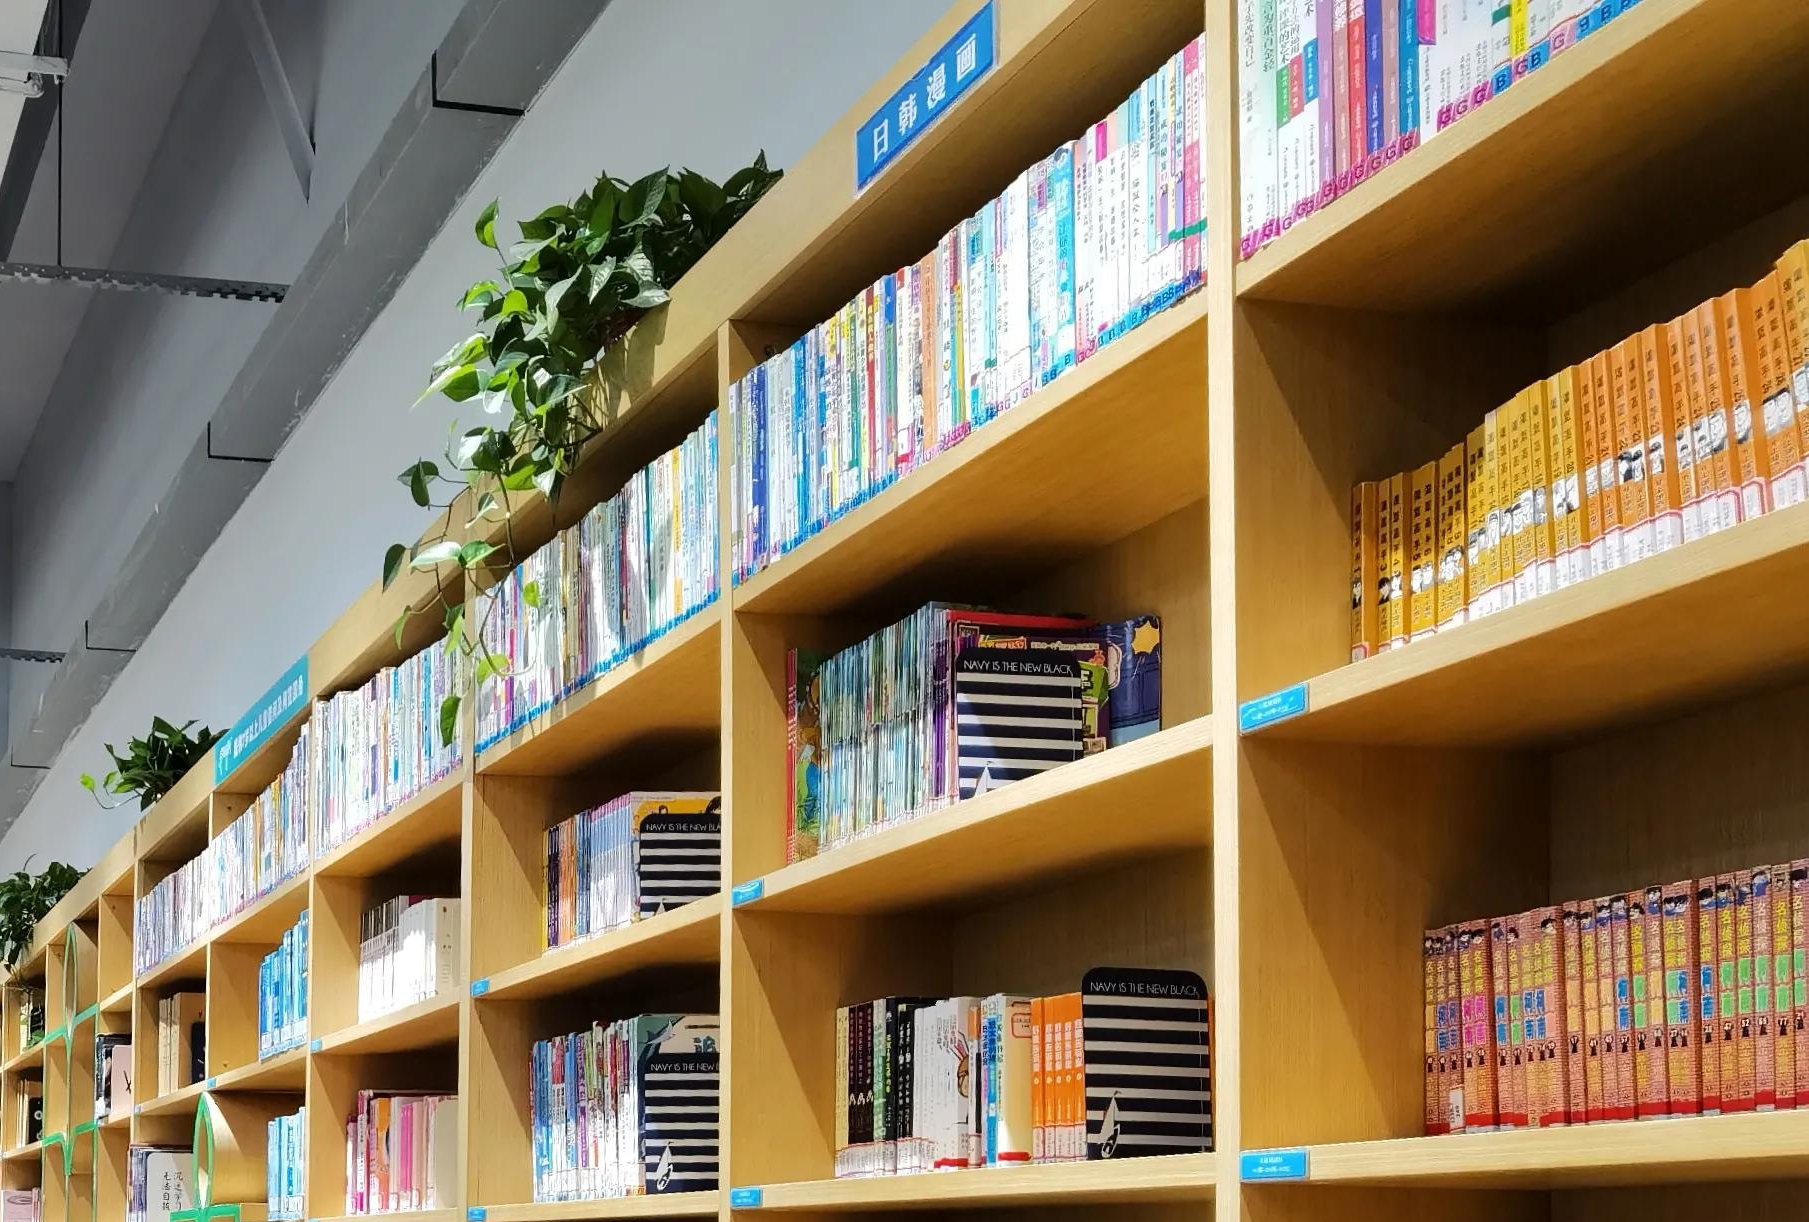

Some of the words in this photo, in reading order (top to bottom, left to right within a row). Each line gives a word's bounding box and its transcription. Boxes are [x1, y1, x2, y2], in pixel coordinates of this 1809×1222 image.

[871, 33, 978, 163] 日韩漫画
[963, 660, 991, 671] NAVY
[992, 661, 1001, 672] IS
[1002, 662, 1019, 673] THE
[1019, 663, 1043, 674] NEW
[1043, 664, 1072, 675] BLACK
[646, 823, 667, 831] NAVY
[668, 823, 675, 831] IS
[675, 823, 688, 831] THE
[1090, 981, 1117, 993] NAVY
[1119, 982, 1127, 993] IS
[1128, 982, 1145, 994] THE
[1146, 983, 1169, 995] NEW
[1171, 984, 1198, 996] BLACK
[650, 1063, 673, 1071] NAVY
[674, 1063, 680, 1071] IS
[682, 1063, 695, 1071] THE
[696, 1063, 715, 1071] NEW
